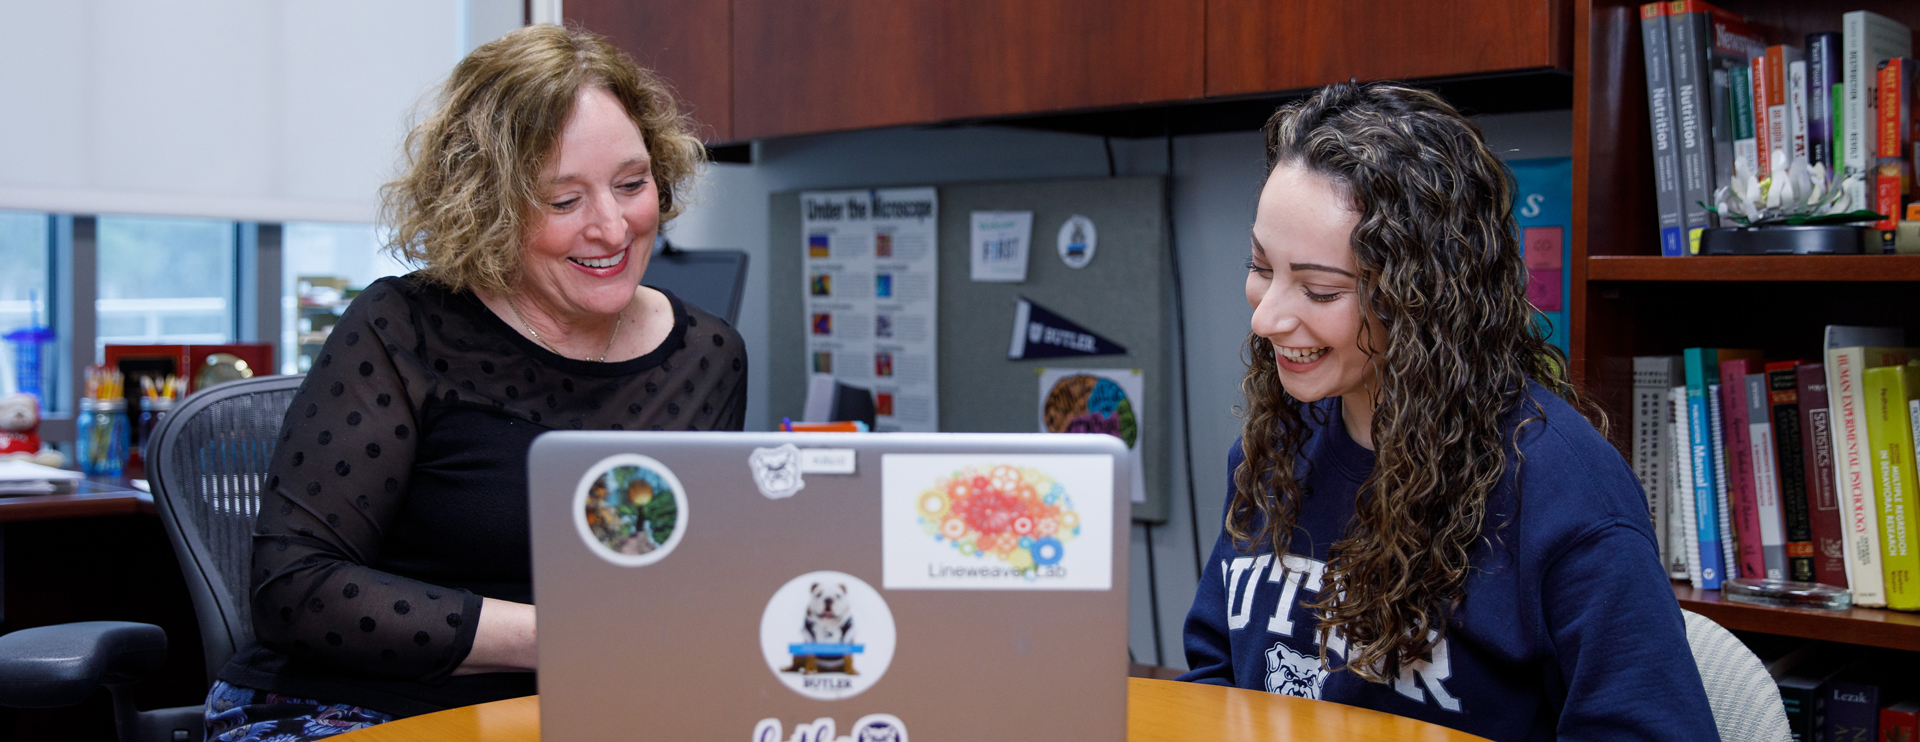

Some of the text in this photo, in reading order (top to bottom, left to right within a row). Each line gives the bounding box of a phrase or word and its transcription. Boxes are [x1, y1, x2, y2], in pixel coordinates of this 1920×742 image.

[1811, 41, 1822, 120] Fast Food Nation
[1849, 50, 1858, 100] DESTRUCTION
[1653, 87, 1670, 150] Nutrition
[1680, 84, 1697, 148] Nutrition
[1755, 87, 1764, 119] PLANET
[1886, 66, 1896, 156] FAST FOOD NATION
[1773, 122, 1782, 144] apple
[1850, 132, 1858, 159] REVOLT
[808, 198, 932, 225] Under the Microscope
[1044, 326, 1097, 354] BUTLER
[1752, 381, 1760, 409] STEVENS
[1837, 354, 1850, 393] HUMAN
[1692, 404, 1701, 444] PUBLICATION
[1813, 413, 1829, 467] STATISTICS
[1842, 395, 1860, 469] EXPERIMENTAL
[1639, 421, 1648, 485] ANALYZING
[1650, 392, 1660, 514] DESIGNING EXPERIM
[1694, 445, 1709, 488] Manual
[1850, 471, 1867, 535] PSYCHOLOGY
[1880, 450, 1897, 557] IN BEHAVIORAL RESEARCH
[1892, 465, 1908, 556] MULTIPLE REGRESSION
[928, 563, 1067, 577] Lineweaver Lab
[1222, 553, 1462, 713] UTR
[803, 677, 852, 688] BUTLER
[1834, 690, 1868, 703] Lezak
